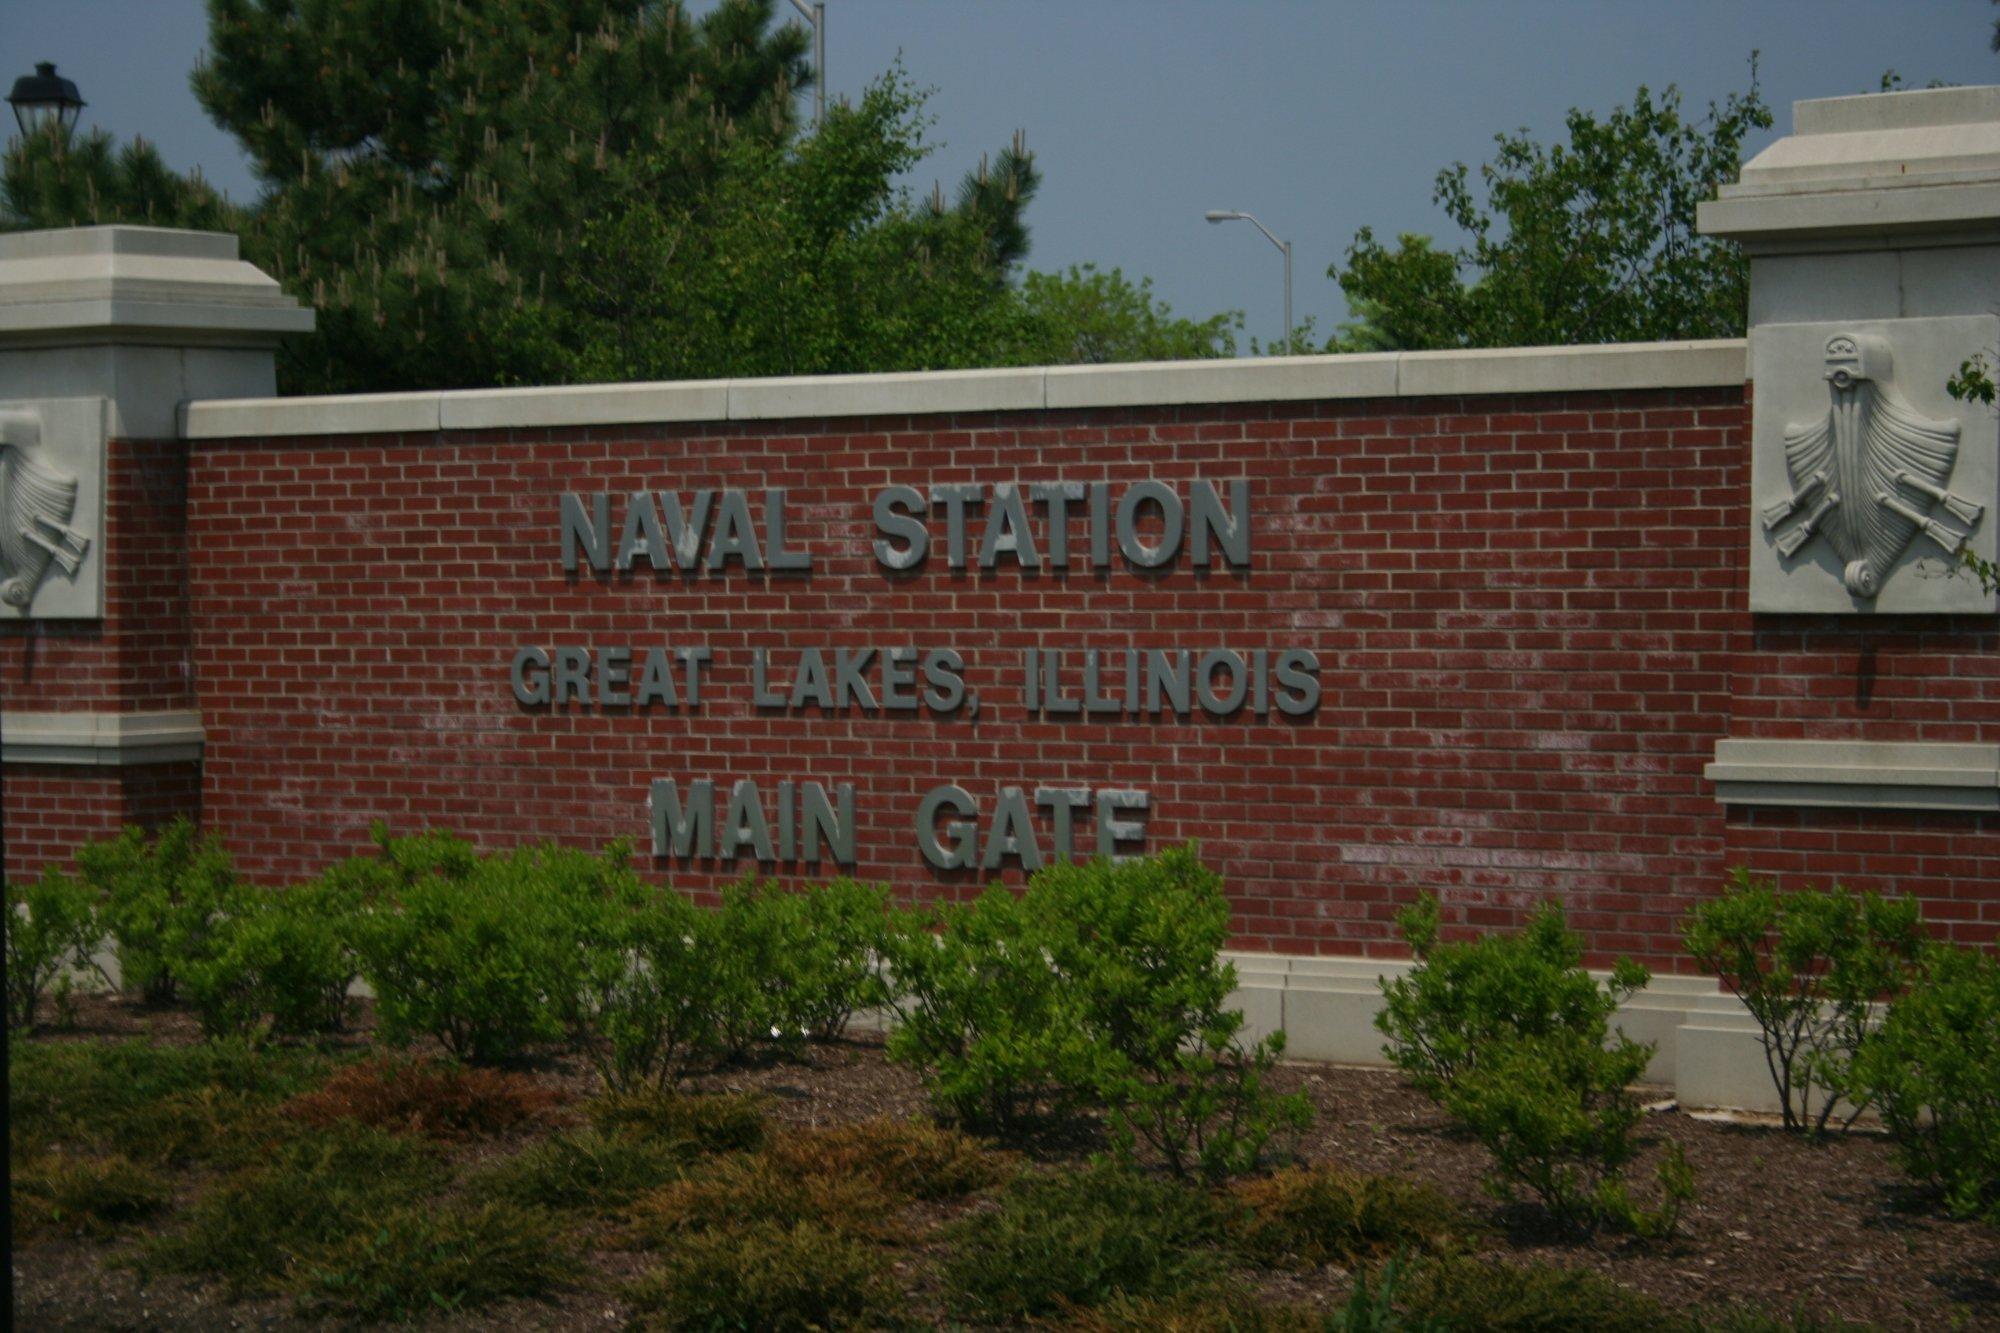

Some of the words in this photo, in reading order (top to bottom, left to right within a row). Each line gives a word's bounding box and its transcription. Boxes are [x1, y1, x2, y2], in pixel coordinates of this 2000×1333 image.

[560, 487, 811, 571] NAVAL
[872, 479, 1251, 570] STATION
[511, 646, 711, 707] GREAT
[753, 647, 979, 717] LAKES,
[1025, 648, 1320, 715] ILLINOIS
[648, 777, 856, 864] MAIN
[917, 784, 1150, 870] GATE
